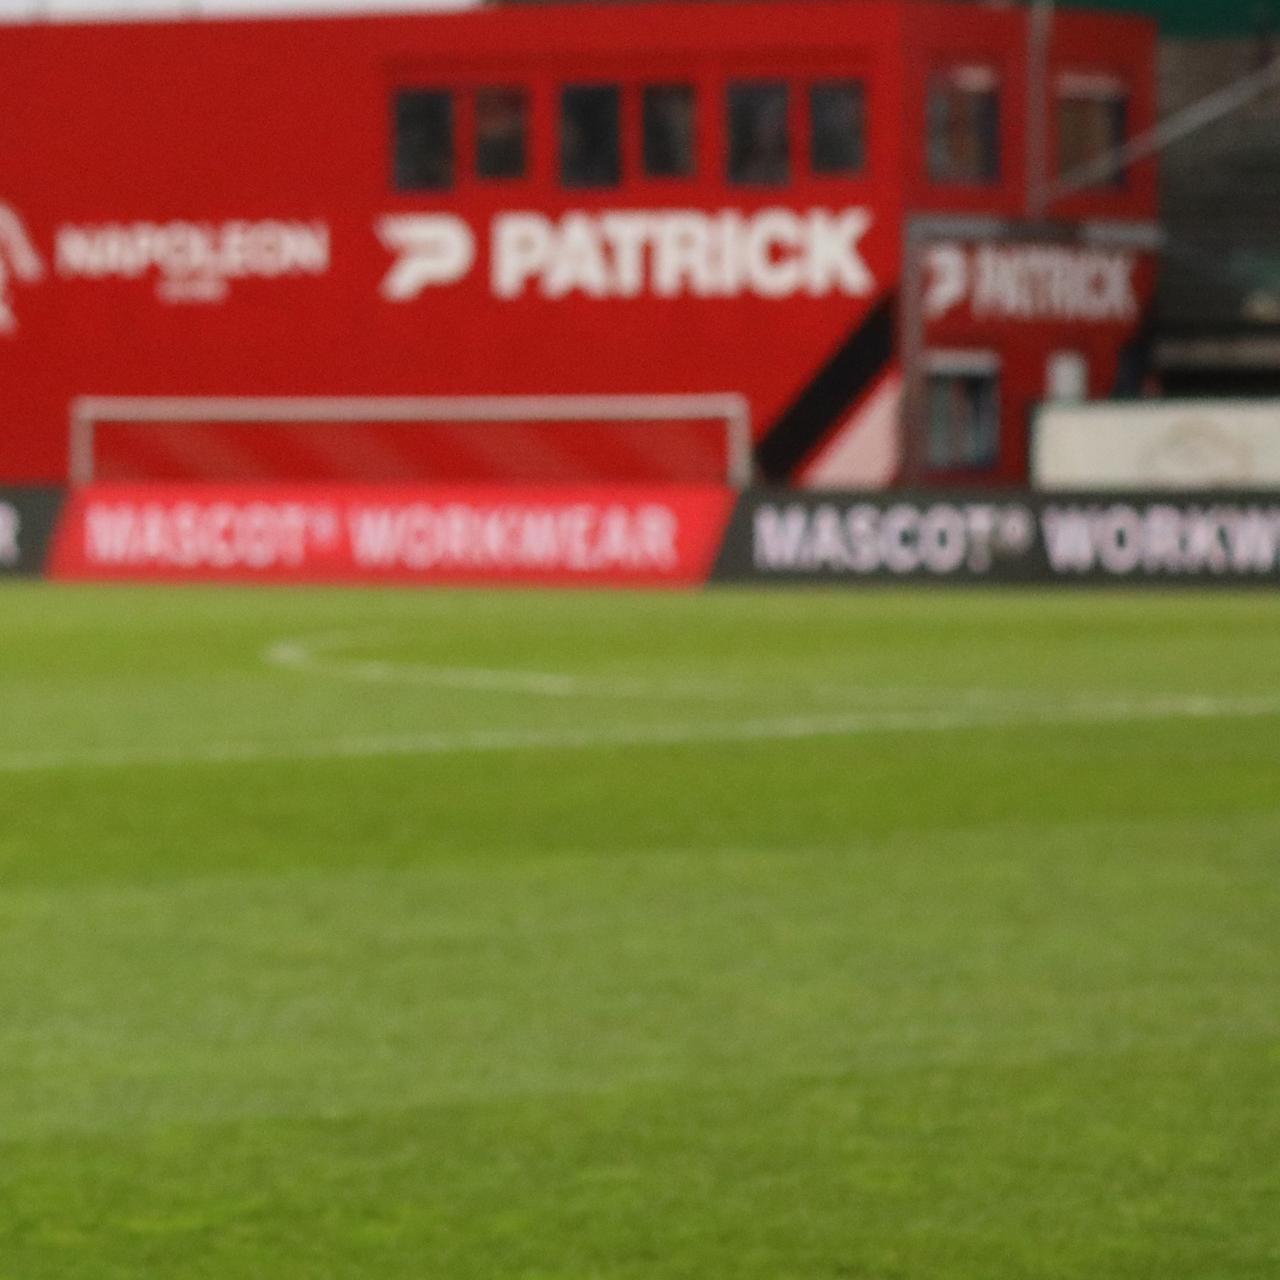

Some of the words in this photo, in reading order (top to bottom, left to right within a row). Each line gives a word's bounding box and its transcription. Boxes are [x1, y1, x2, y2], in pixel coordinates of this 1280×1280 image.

[54, 221, 330, 278] NAPOLEON
[490, 208, 872, 298] PATRICK
[973, 244, 1137, 316] PATRICK
[349, 503, 678, 570] WORKWEAR
